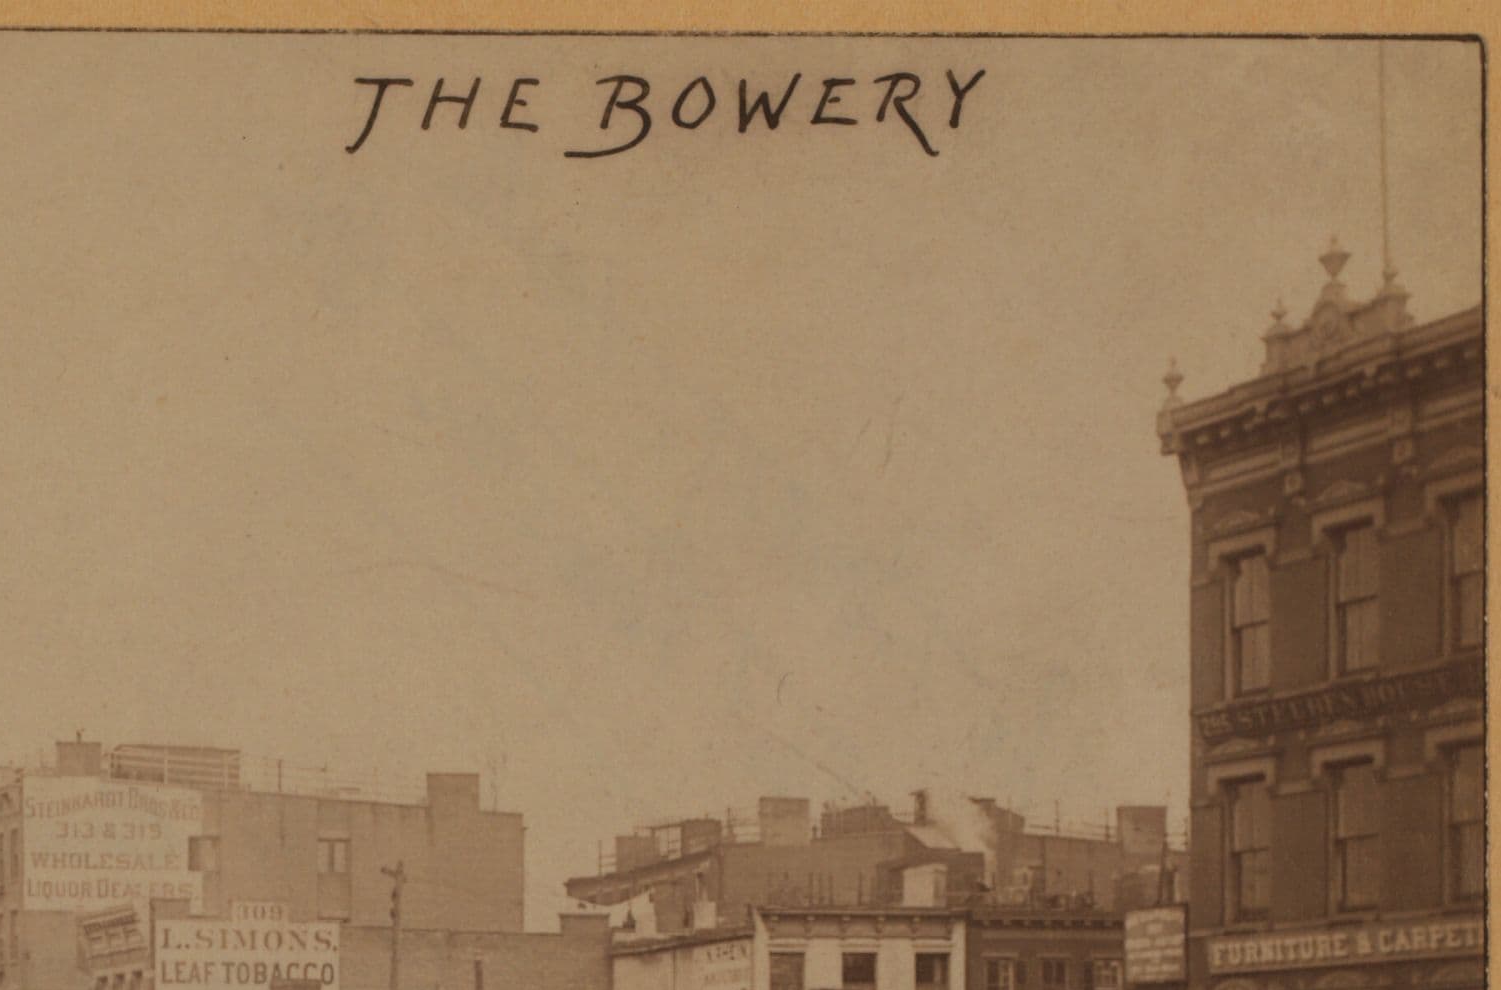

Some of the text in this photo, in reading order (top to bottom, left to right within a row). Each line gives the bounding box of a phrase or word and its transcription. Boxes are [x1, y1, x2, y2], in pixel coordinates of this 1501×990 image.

[55, 821, 94, 840] 313
[102, 821, 117, 840] &
[30, 851, 182, 871] WHOLESALE
[27, 878, 194, 899] LIQUOR DEALERS
[1211, 932, 1349, 967] FURNITURE
[1354, 930, 1373, 955] &
[161, 961, 335, 985] LEAF TOBACCO
